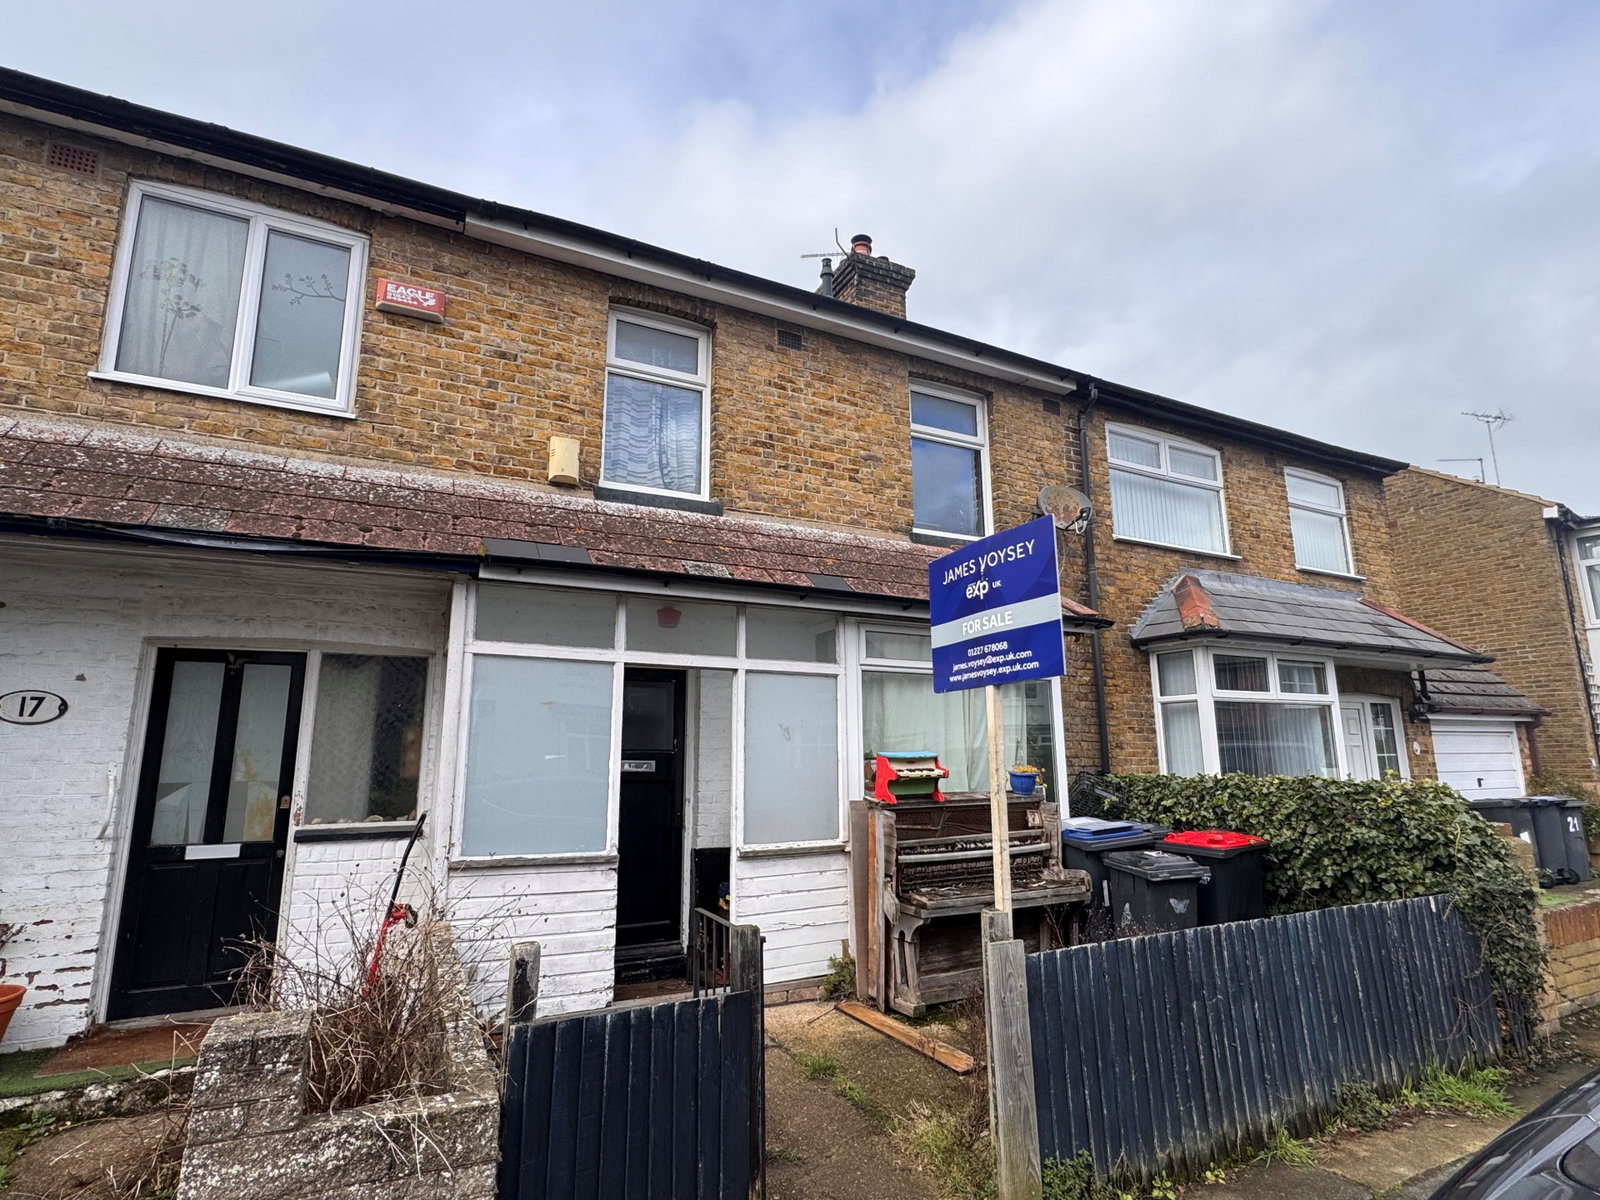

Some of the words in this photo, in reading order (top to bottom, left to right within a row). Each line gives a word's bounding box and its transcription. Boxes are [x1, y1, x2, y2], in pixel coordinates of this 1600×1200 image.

[387, 283, 434, 300] EAGLE
[942, 560, 976, 585] JAMES
[978, 539, 1035, 572] VOYSEY
[966, 579, 989, 599] exp
[992, 580, 1002, 588] UK
[962, 619, 981, 636] FOR
[982, 611, 1013, 630] SALE
[968, 648, 983, 656] 01227
[984, 641, 1008, 653] 678068
[949, 661, 1039, 682] www.jamesvoysey.exp.uk.com
[953, 650, 1032, 673] james.voysey@exp.uk.com
[19, 696, 46, 717] 17
[1567, 816, 1579, 832] 21
